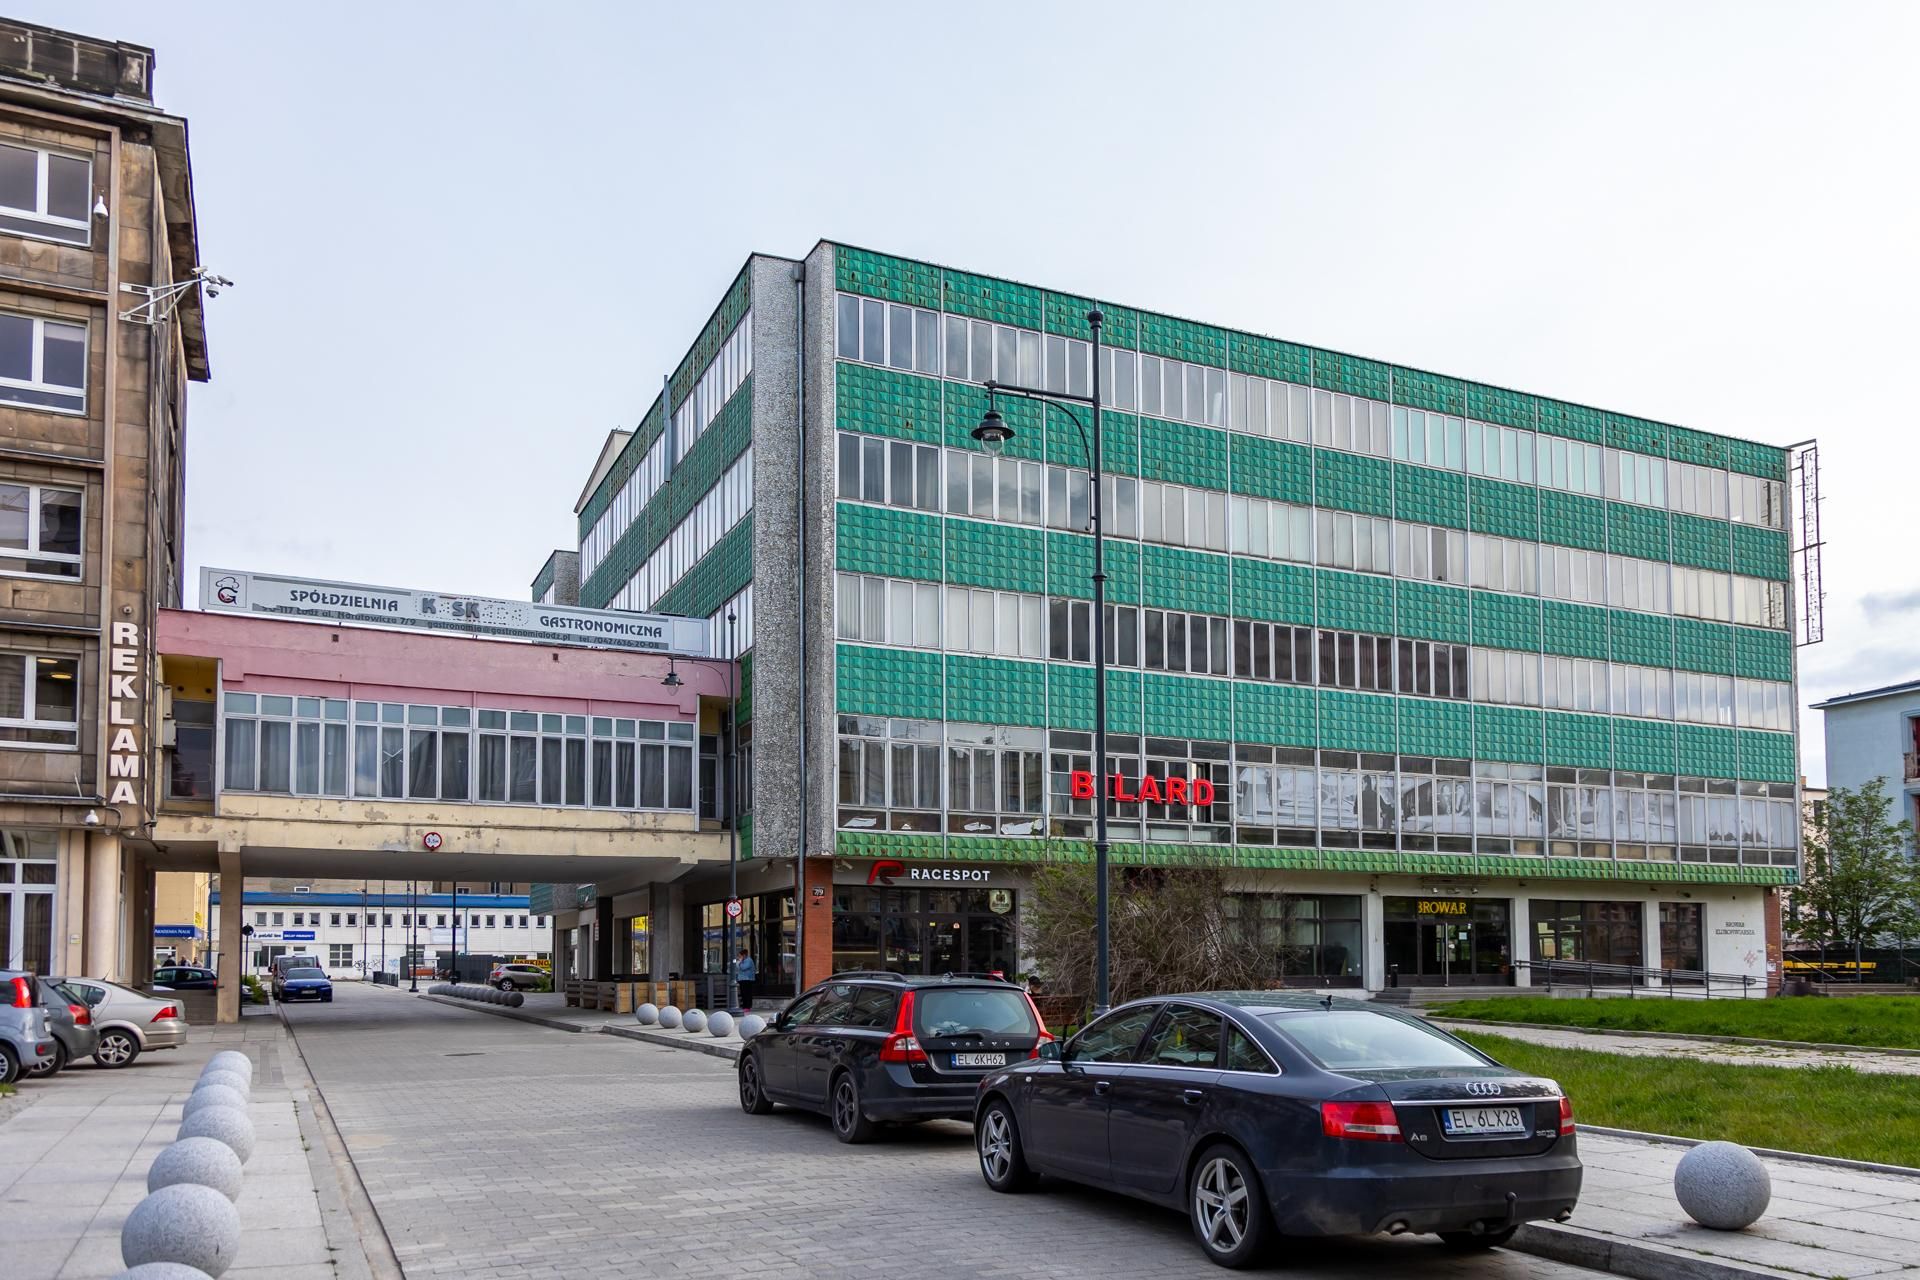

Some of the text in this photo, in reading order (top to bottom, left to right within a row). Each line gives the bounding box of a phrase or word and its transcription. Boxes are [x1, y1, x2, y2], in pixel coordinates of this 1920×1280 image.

[290, 589, 399, 612] SPÓŁDZIELNIA
[540, 615, 663, 638] GASTRONOMICZNA
[110, 621, 139, 805] REKLAMA
[911, 868, 991, 881] RACESPOT
[957, 1054, 1005, 1066] EL 6KH62
[1452, 1111, 1472, 1128] EL
[1478, 1110, 1521, 1127] 6LX28
